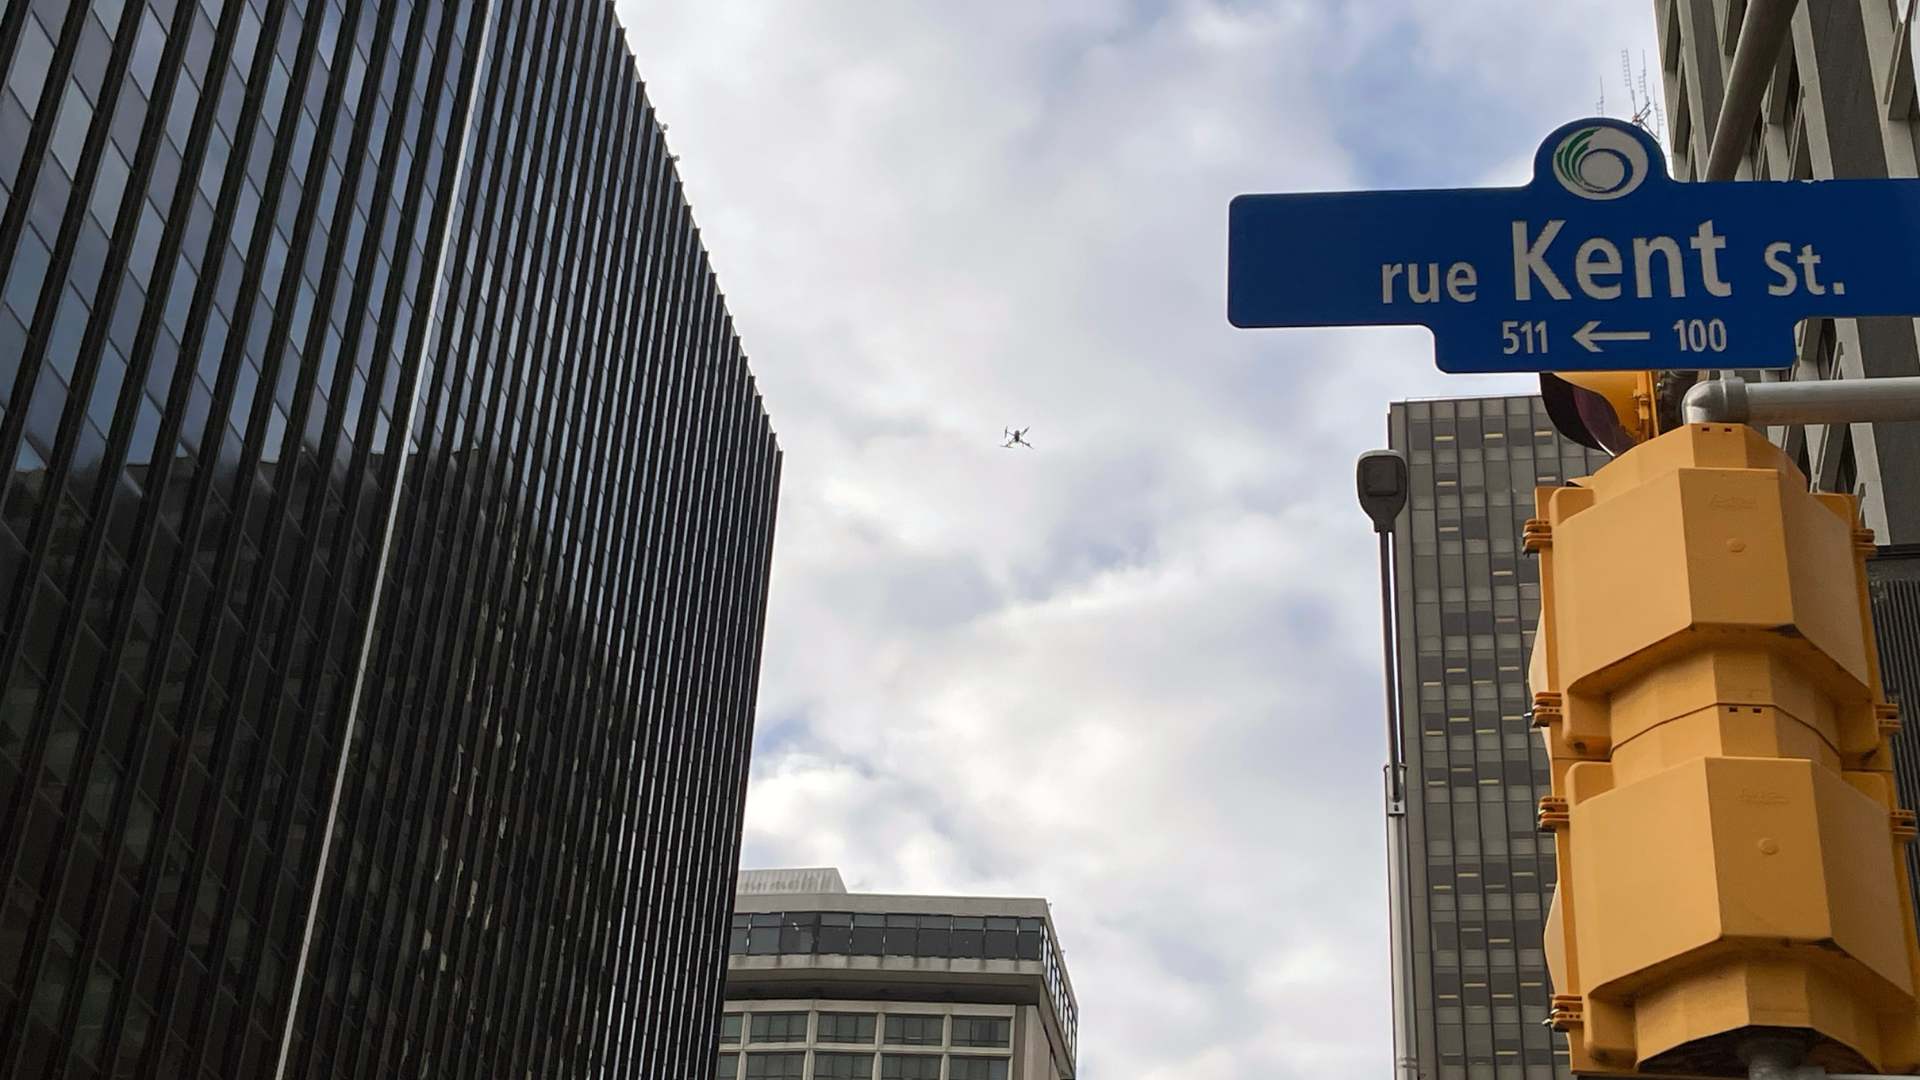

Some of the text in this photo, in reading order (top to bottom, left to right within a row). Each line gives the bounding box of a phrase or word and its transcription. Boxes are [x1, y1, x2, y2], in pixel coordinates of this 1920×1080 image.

[1380, 219, 1846, 304] rue Kent St.
[1501, 319, 1728, 355] 511 100
